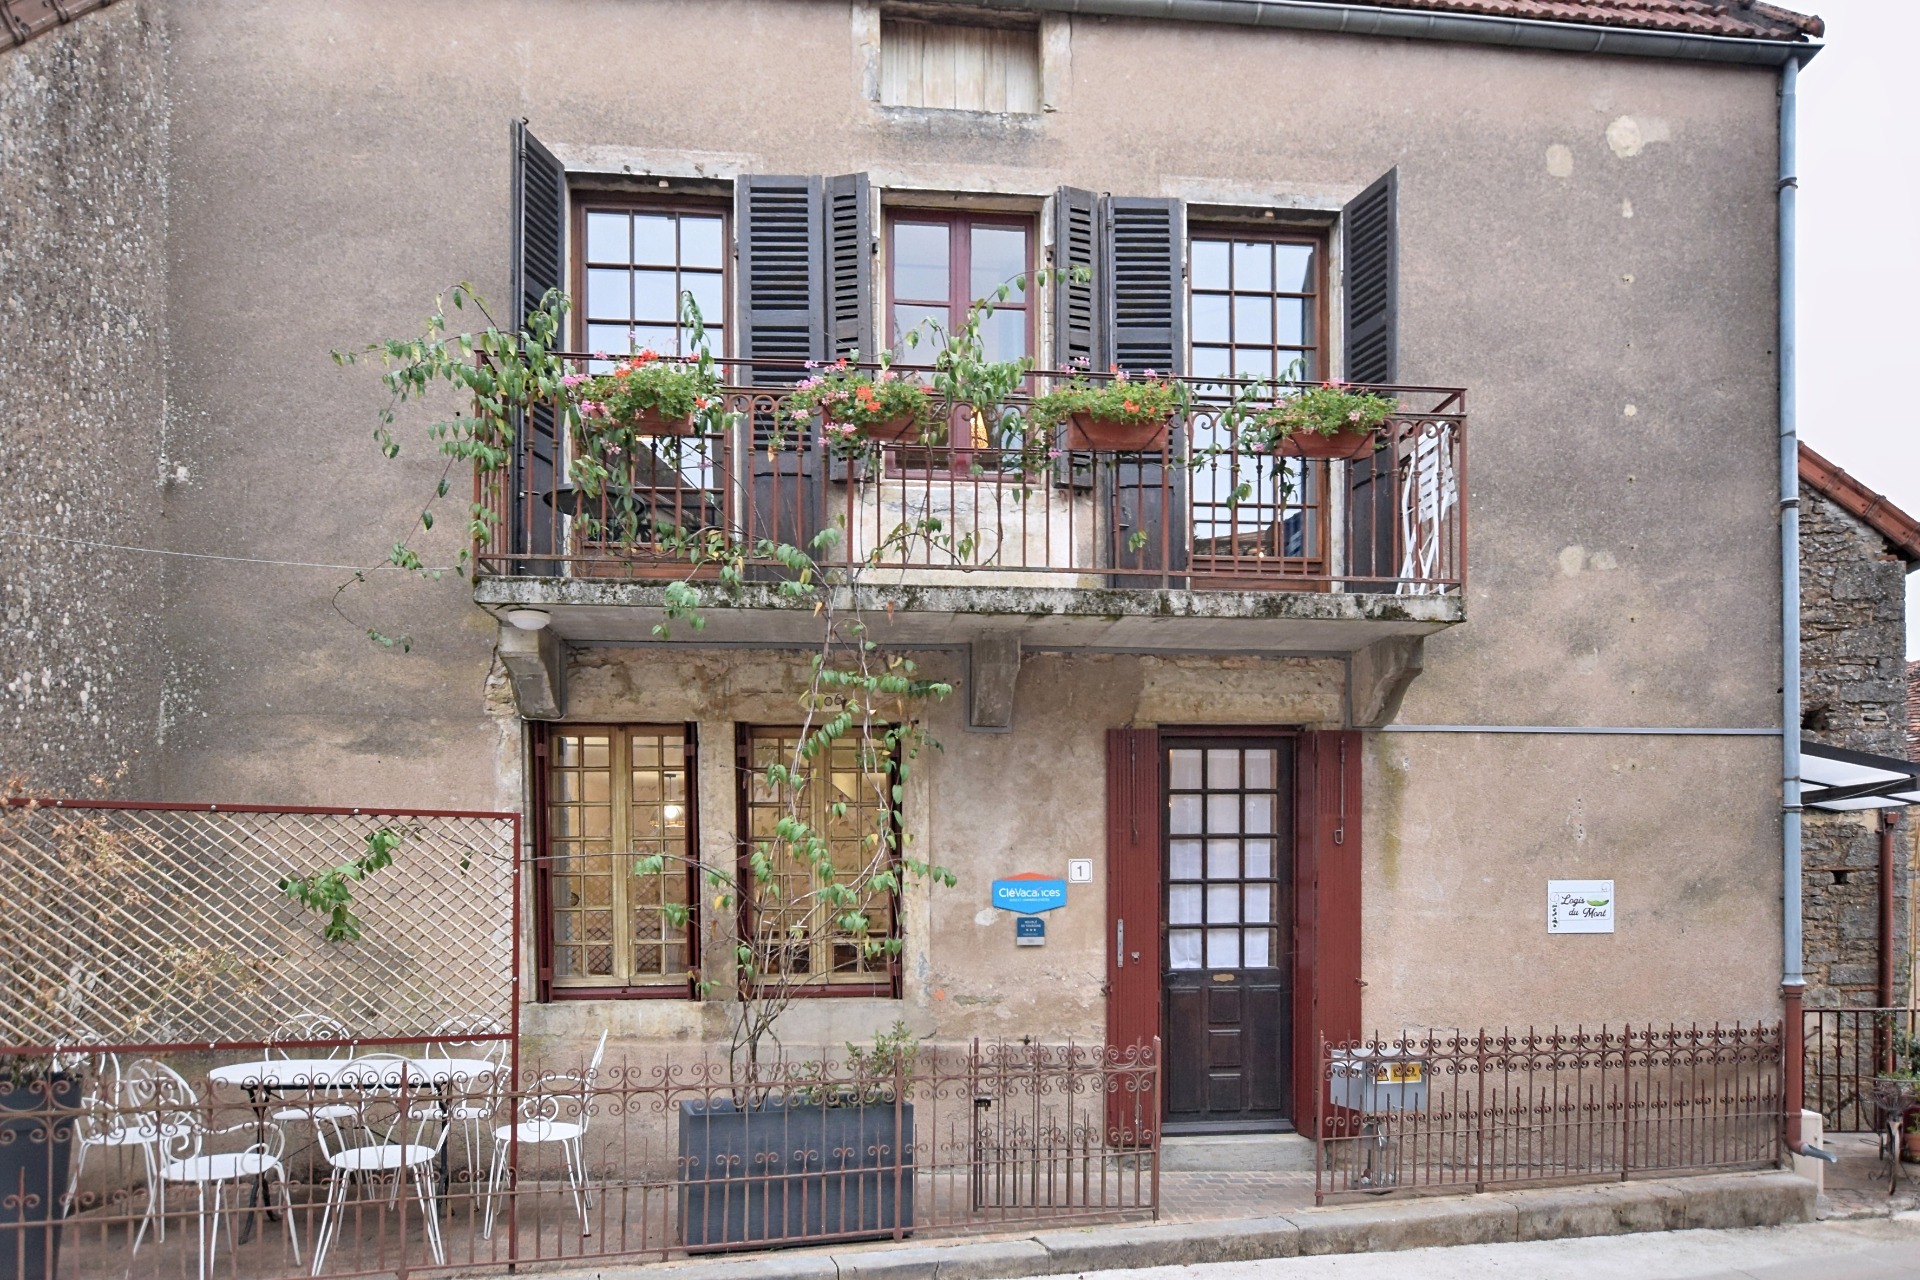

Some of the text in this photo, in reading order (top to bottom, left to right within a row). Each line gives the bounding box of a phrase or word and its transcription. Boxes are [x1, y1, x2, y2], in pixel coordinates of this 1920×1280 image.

[1076, 865, 1083, 877] 1
[1560, 894, 1586, 907] Logis
[1568, 907, 1607, 918] du Mont
